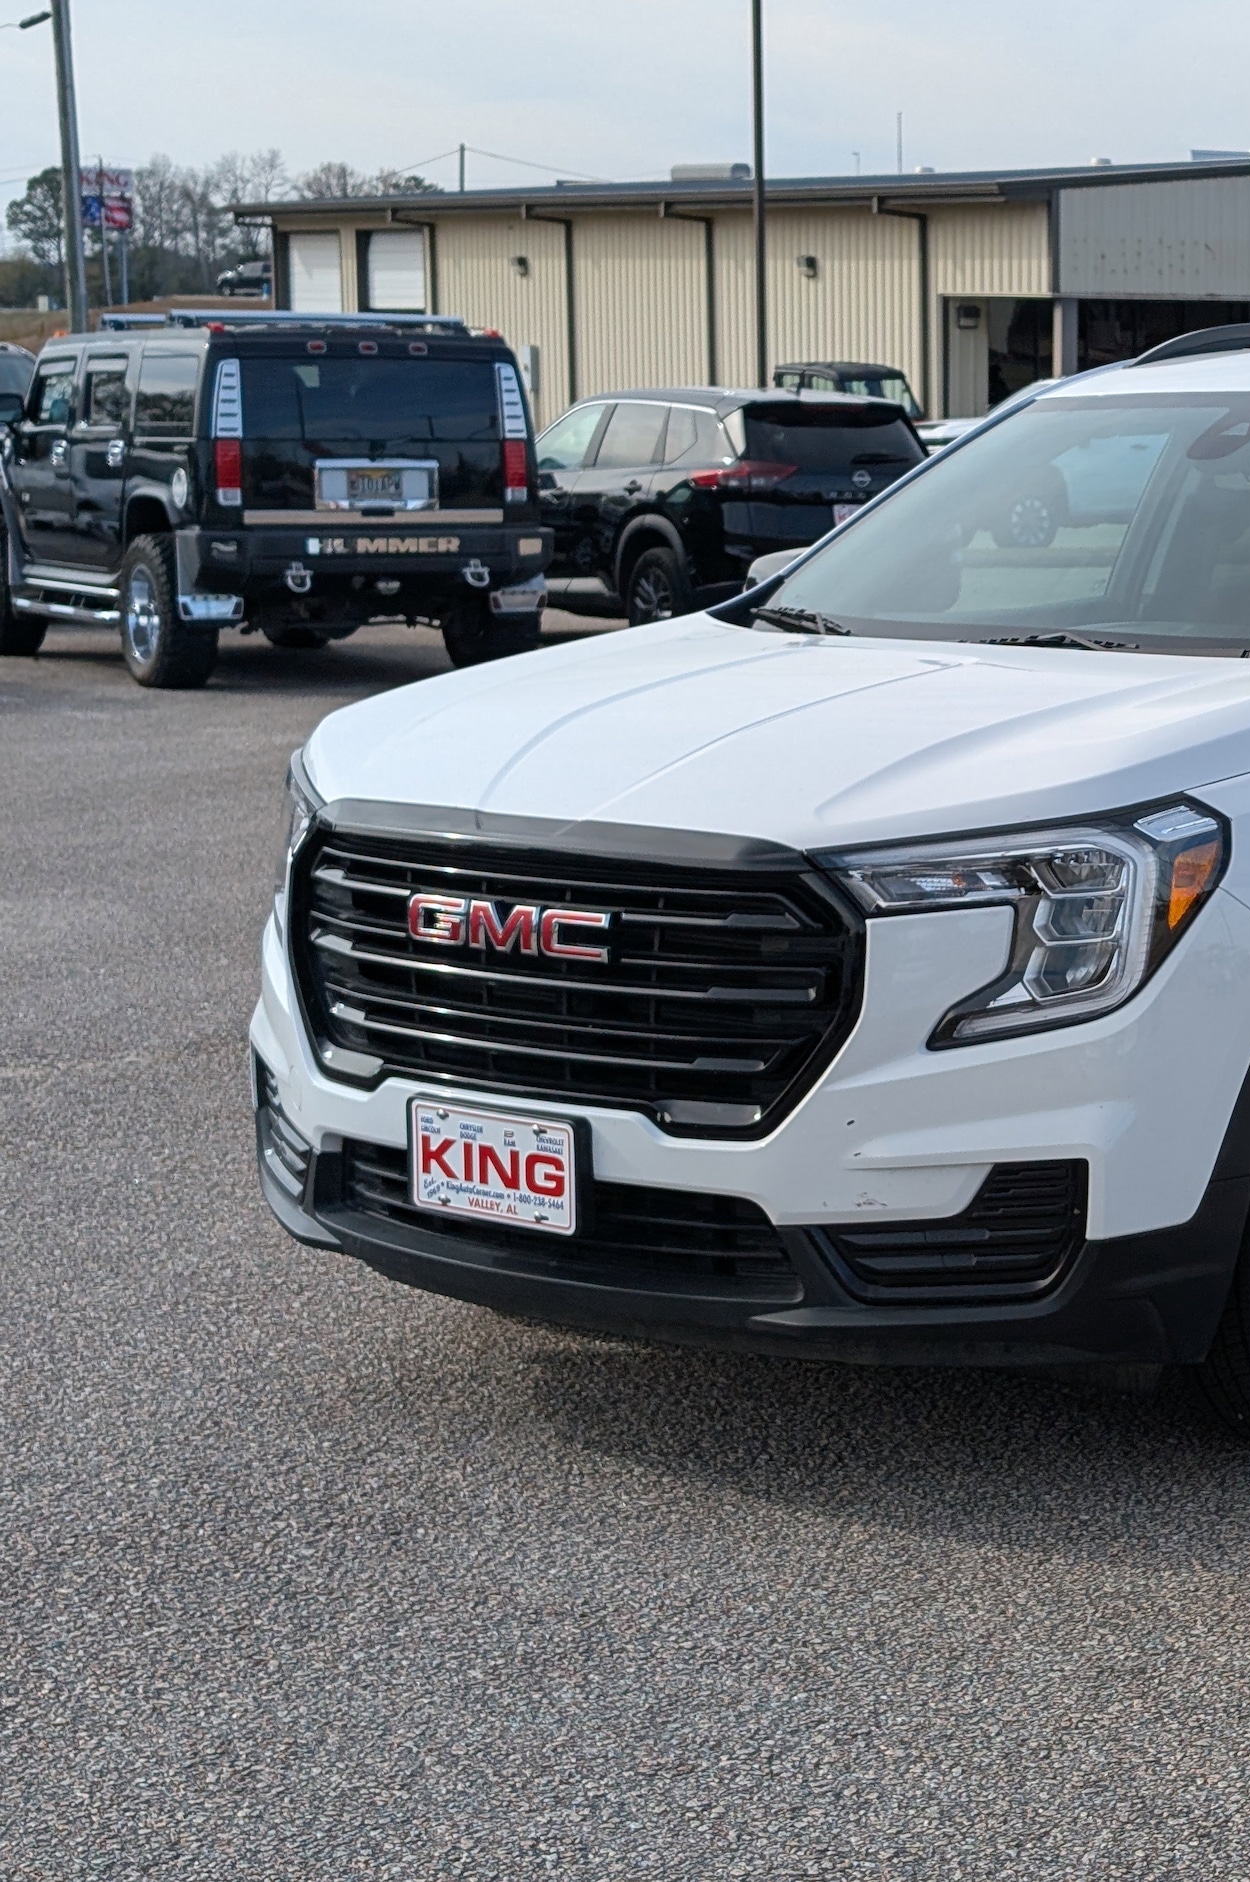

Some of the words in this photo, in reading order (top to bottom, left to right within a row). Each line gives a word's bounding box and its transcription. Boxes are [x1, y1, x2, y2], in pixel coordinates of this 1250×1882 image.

[307, 536, 460, 554] HUMMER
[408, 893, 611, 964] GMC
[459, 1122, 483, 1133] CHRYSLER
[421, 1133, 565, 1197] KING
[446, 1181, 505, 1199] KingAutoCorner.com
[513, 1192, 564, 1210] 1-800-238-5464
[467, 1196, 503, 1213] VALLEY,
[506, 1203, 519, 1215] AL
